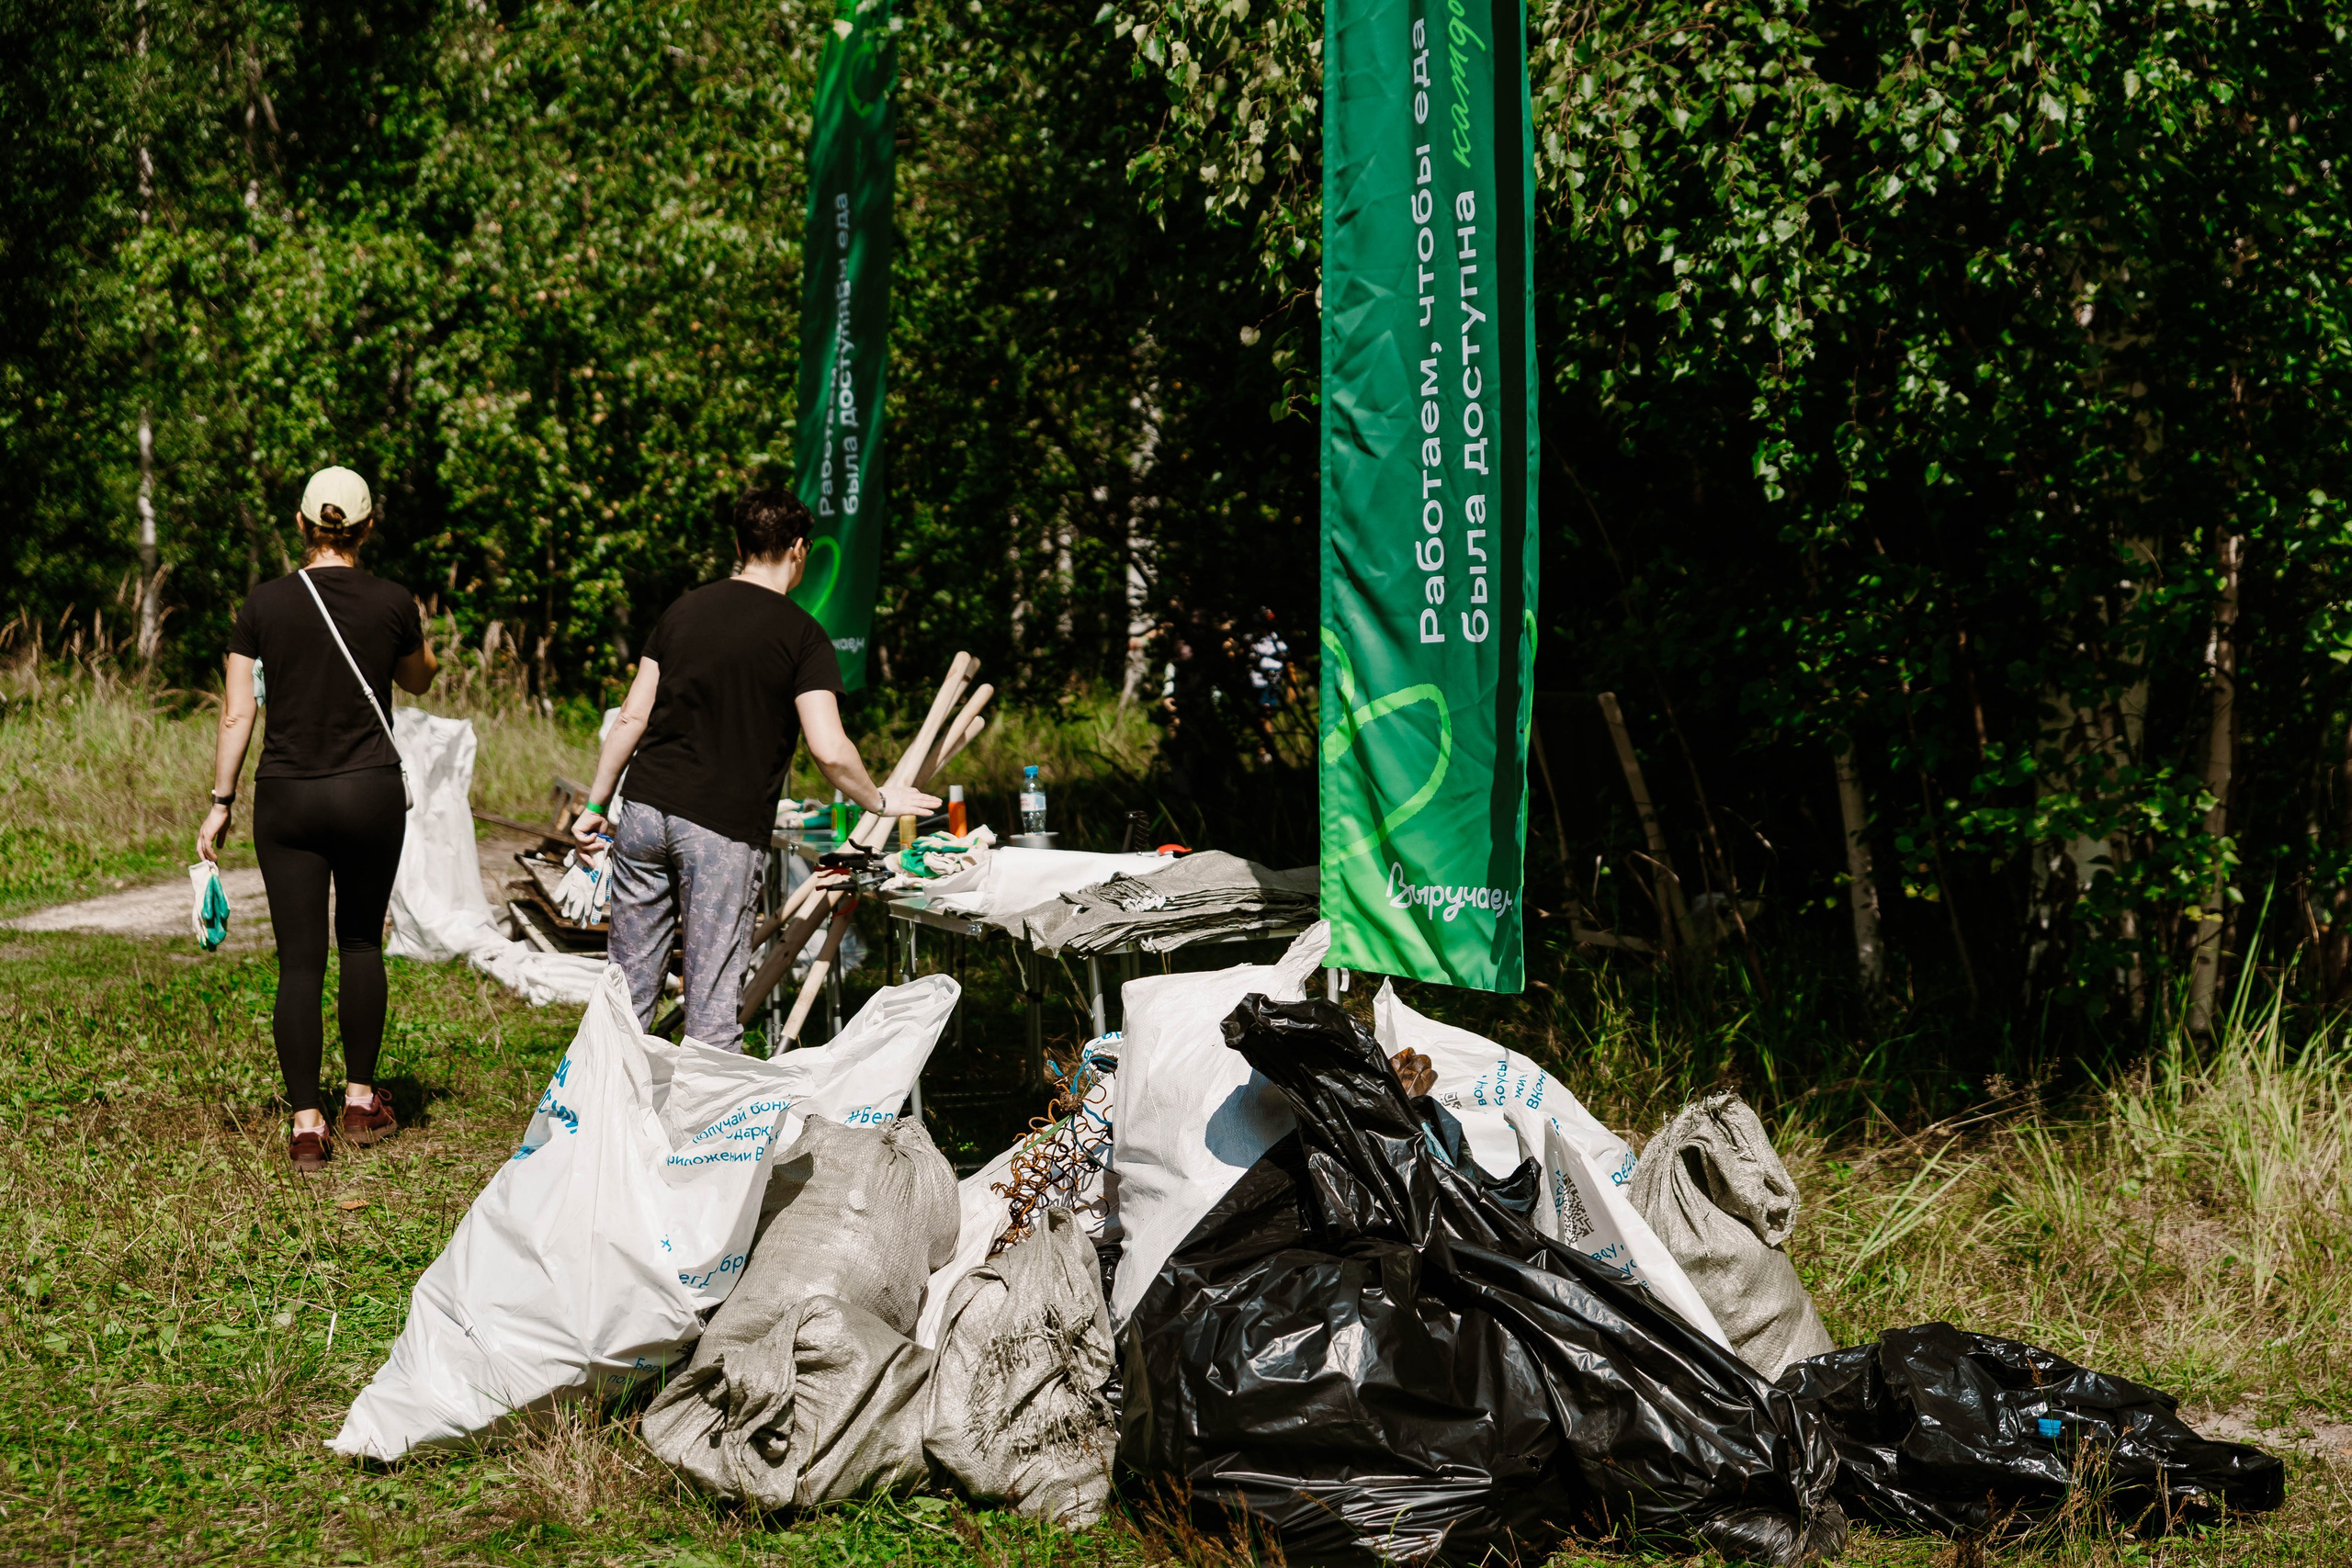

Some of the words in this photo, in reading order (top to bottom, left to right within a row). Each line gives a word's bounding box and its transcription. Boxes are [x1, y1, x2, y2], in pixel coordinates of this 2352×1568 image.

[1412, 17, 1430, 125] еда
[1411, 143, 1435, 327] чтобы
[1455, 189, 1489, 475] доступна
[842, 435, 860, 515] была
[1415, 341, 1445, 644] Работаем,
[1461, 493, 1489, 643] была
